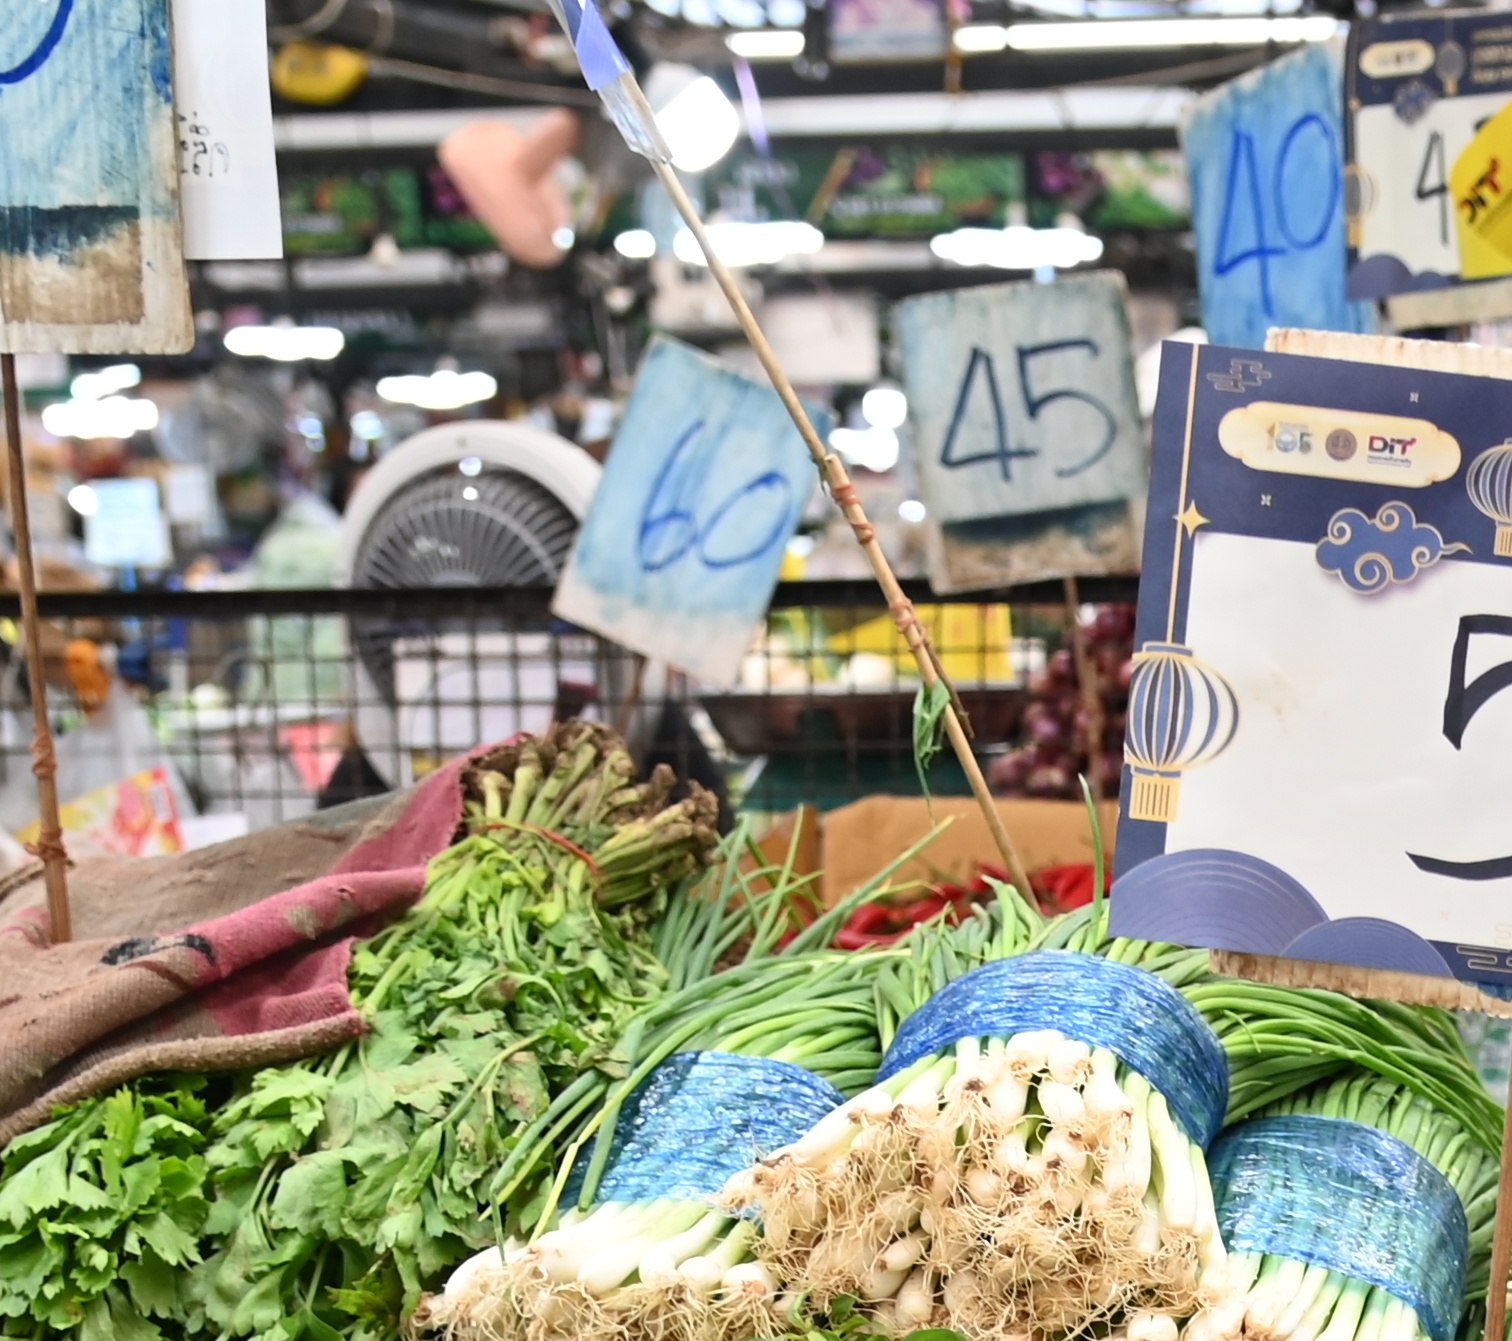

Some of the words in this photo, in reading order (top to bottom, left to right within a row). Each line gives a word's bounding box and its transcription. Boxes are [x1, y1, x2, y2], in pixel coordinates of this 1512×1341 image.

[1213, 112, 1341, 318] 40
[940, 337, 1118, 481] 45
[636, 418, 792, 573] 60
